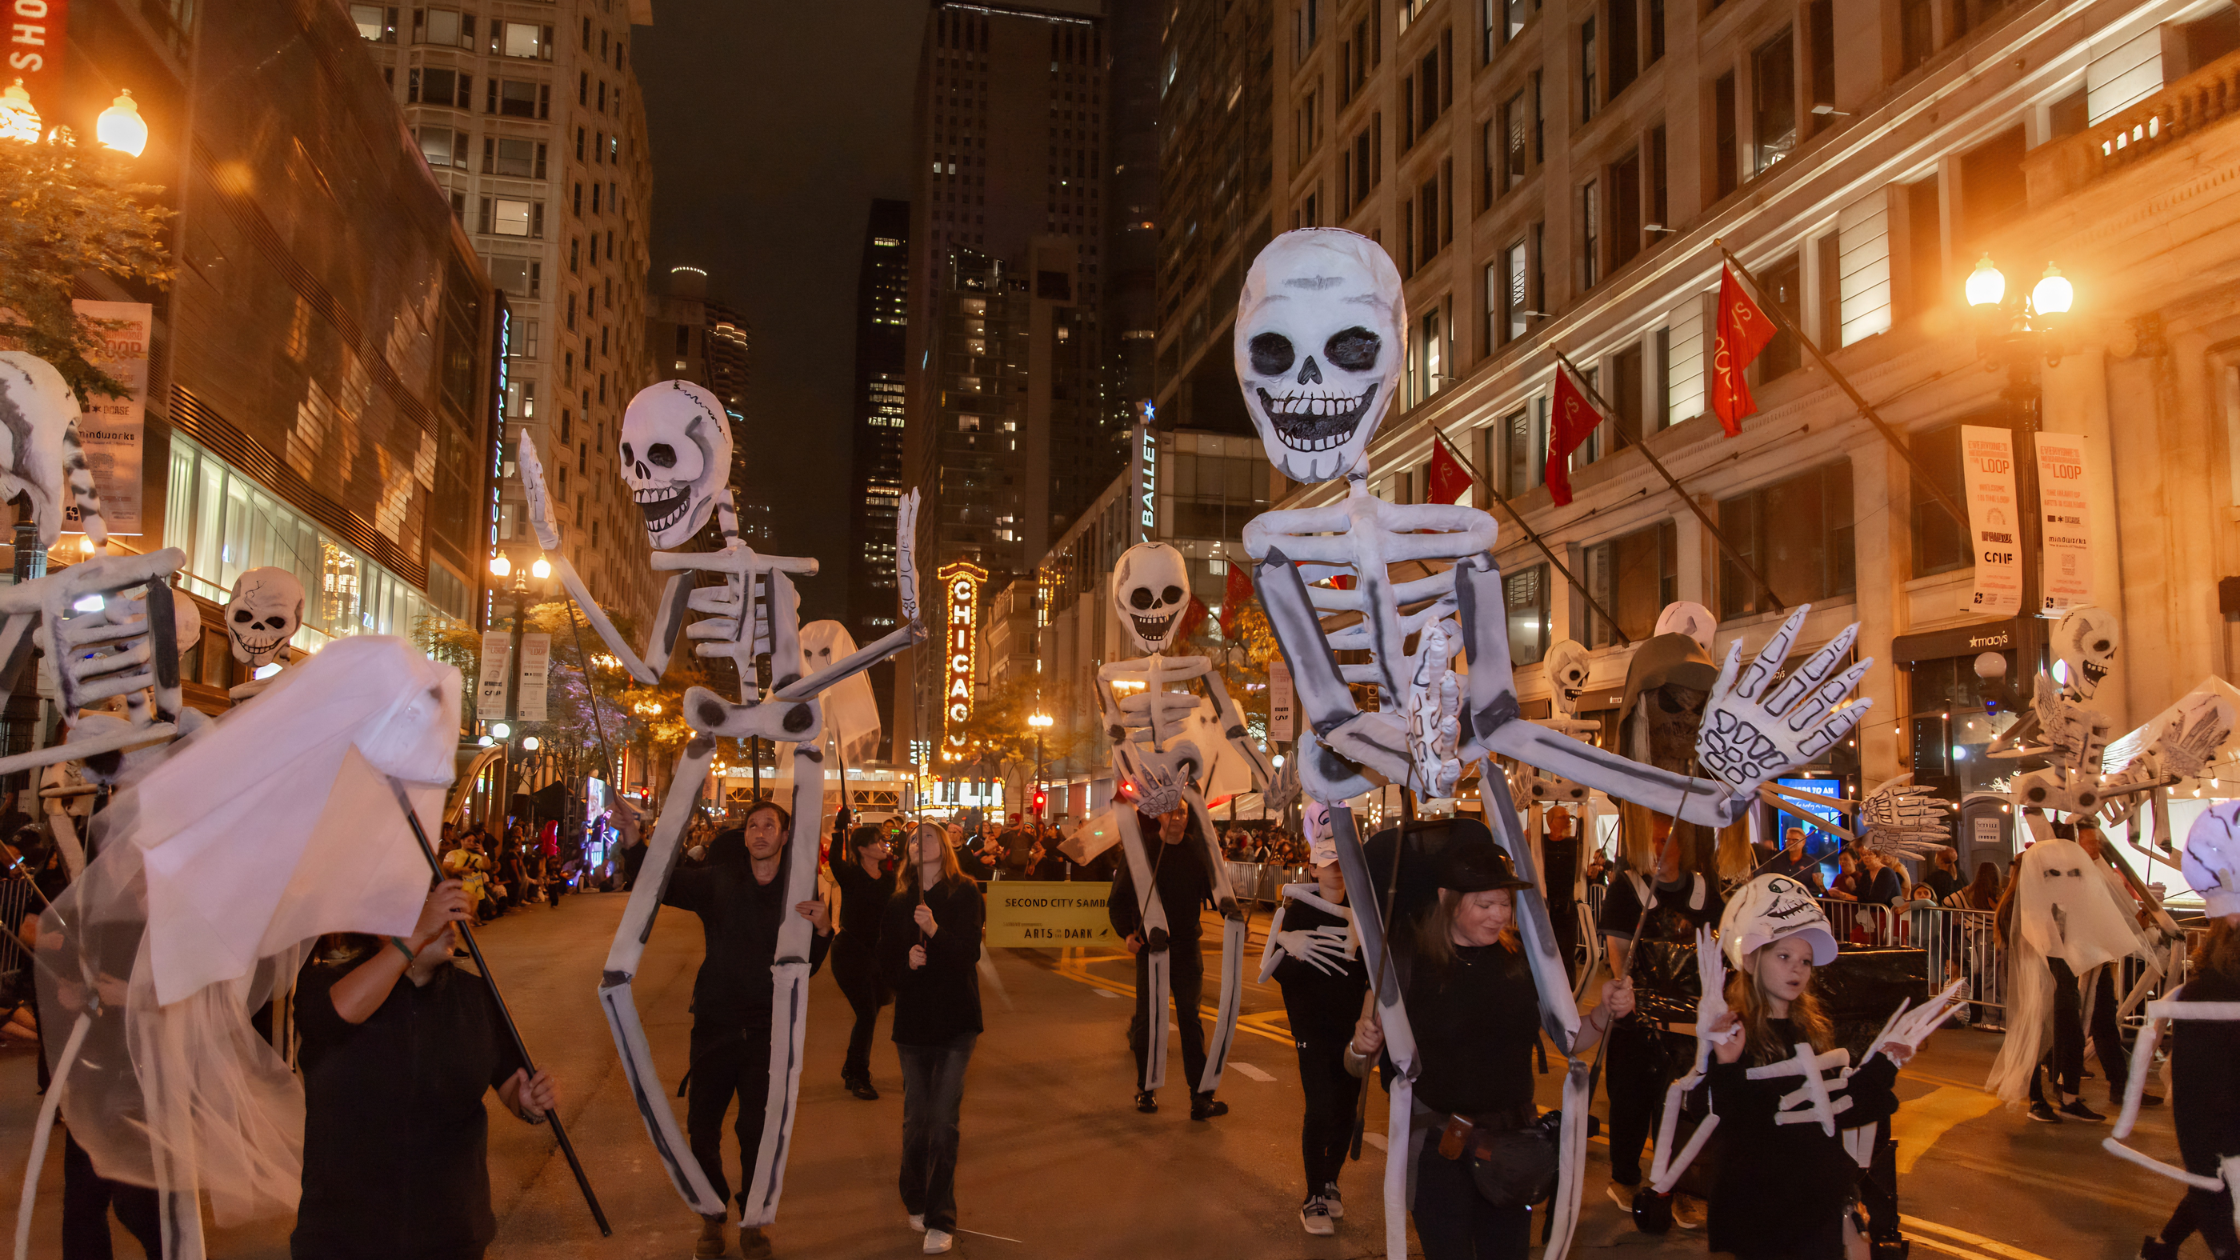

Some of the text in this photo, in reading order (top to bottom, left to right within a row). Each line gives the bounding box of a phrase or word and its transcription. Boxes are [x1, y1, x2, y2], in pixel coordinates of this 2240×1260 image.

[489, 487, 501, 559] LOCK
[500, 309, 510, 391] SEVEN
[1980, 458, 2010, 475] LOOP
[2052, 463, 2082, 480] LOOP
[1141, 428, 1156, 528] BALLET
[1977, 630, 2009, 647] macy's
[949, 581, 971, 747] CHICAGO
[1005, 898, 1048, 908] SECOND
[1050, 898, 1074, 908] CITY
[1023, 928, 1053, 939] ARTS
[1064, 928, 1093, 939] DARK
